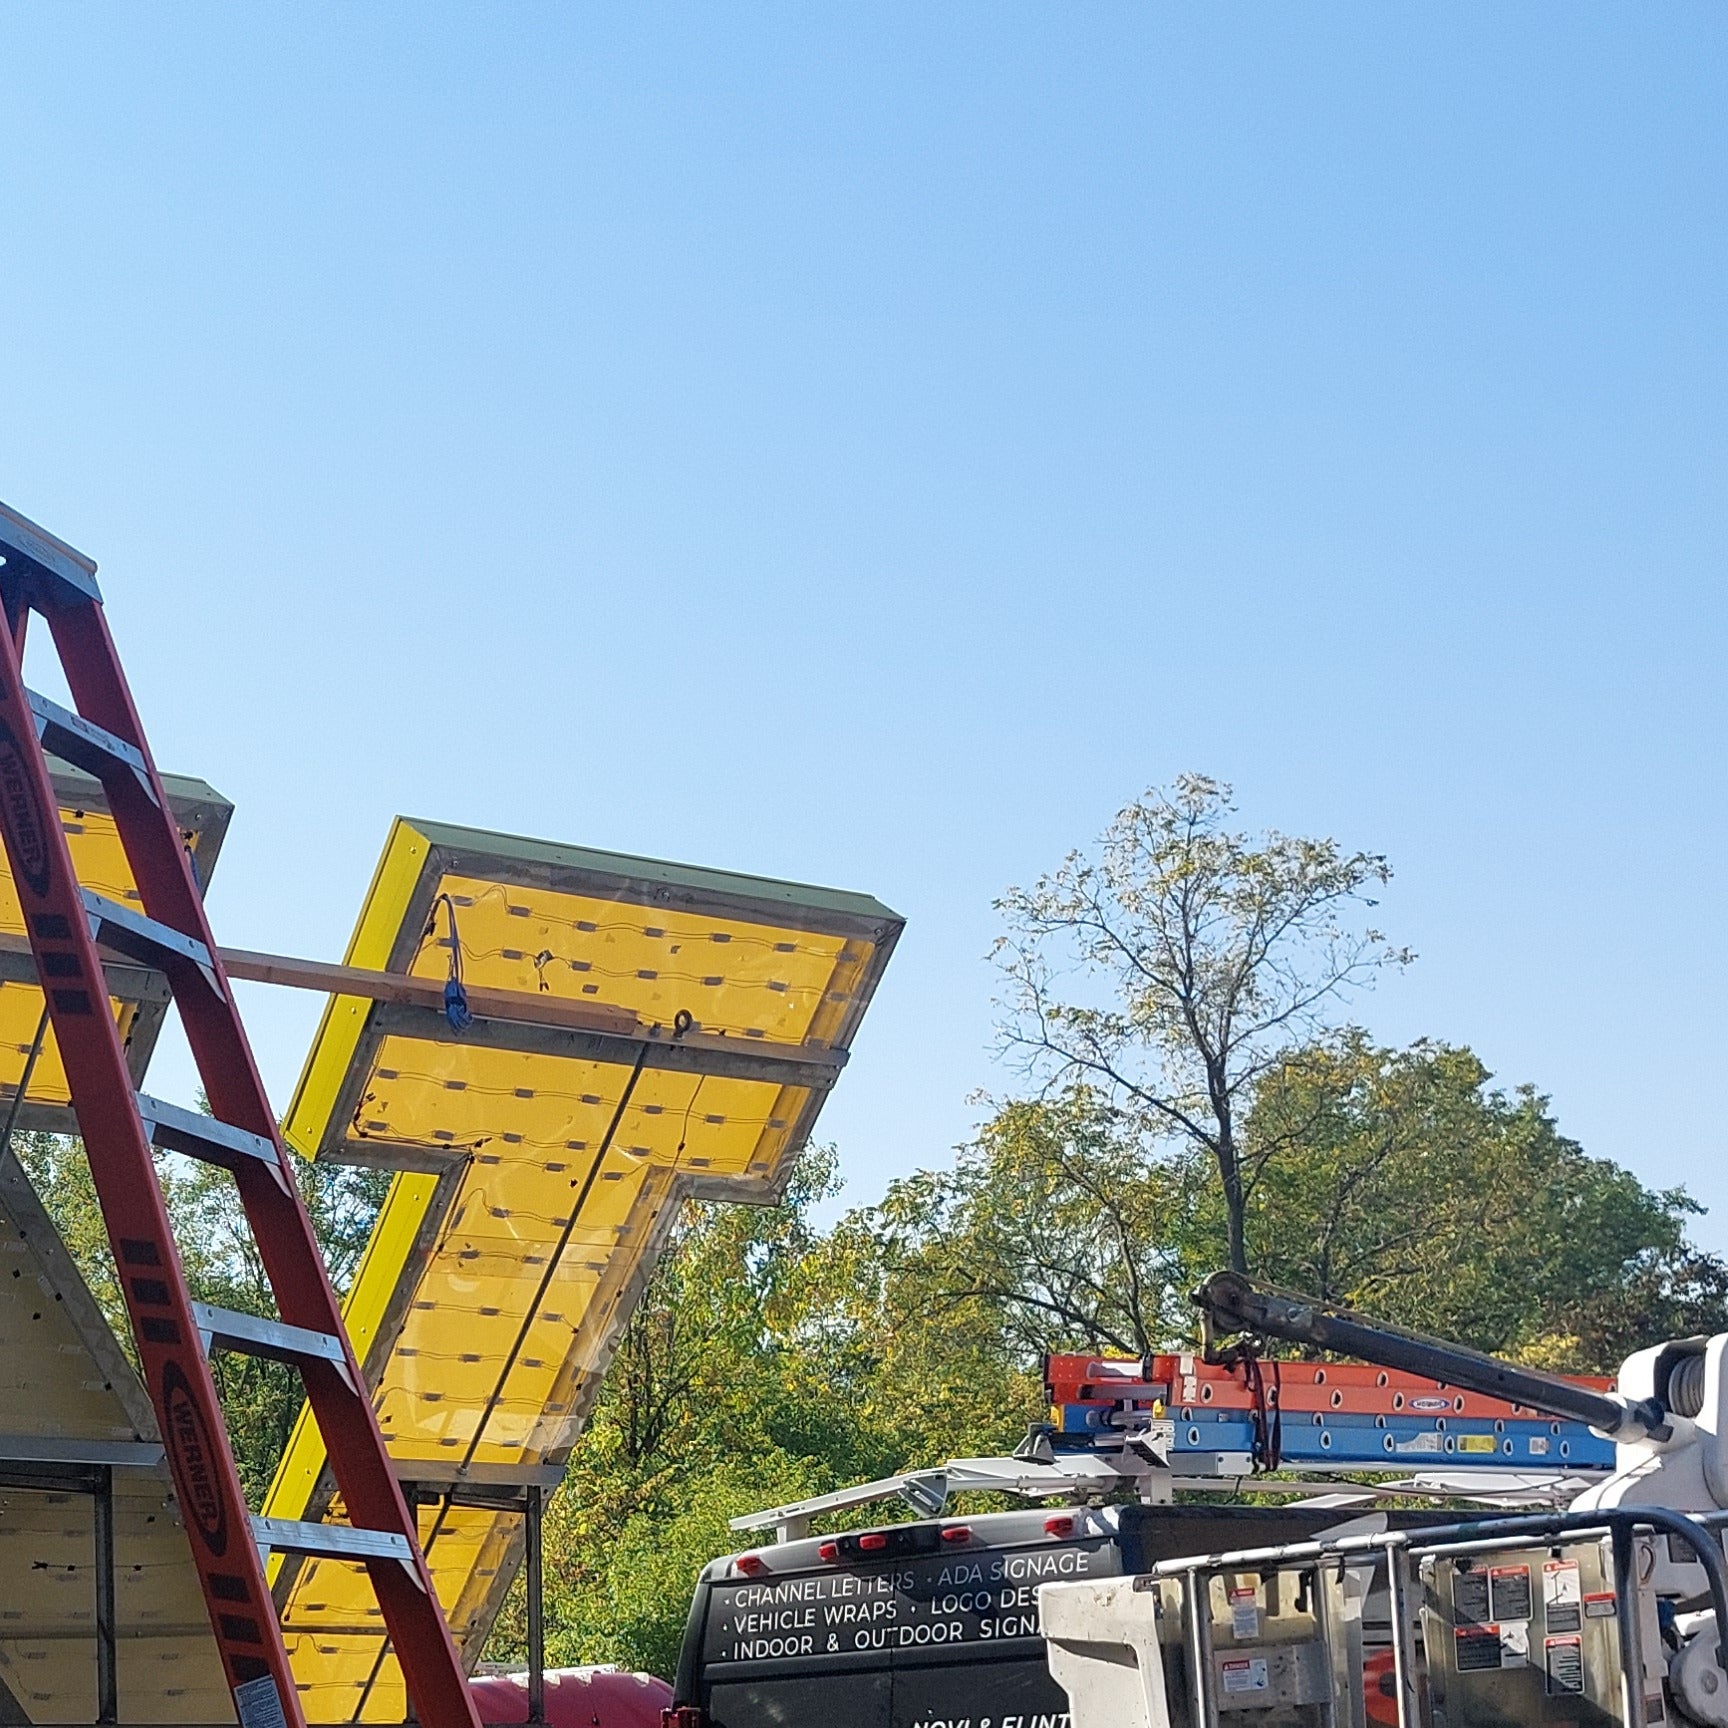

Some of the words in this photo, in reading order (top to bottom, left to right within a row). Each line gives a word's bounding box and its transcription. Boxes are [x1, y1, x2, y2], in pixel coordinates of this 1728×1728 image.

[735, 1581, 826, 1608] CHANNEL
[832, 1571, 914, 1598] LETTERS
[938, 1563, 983, 1587] ADA
[990, 1552, 1089, 1581] SIGNAGE
[734, 1608, 816, 1635] VEHICLE
[824, 1600, 897, 1627] WRAPS
[931, 1591, 991, 1614] LOGO
[1000, 1586, 1040, 1608] DES
[733, 1636, 813, 1660] INDOOR
[827, 1632, 839, 1652] &
[855, 1622, 963, 1648] OUTDOOR
